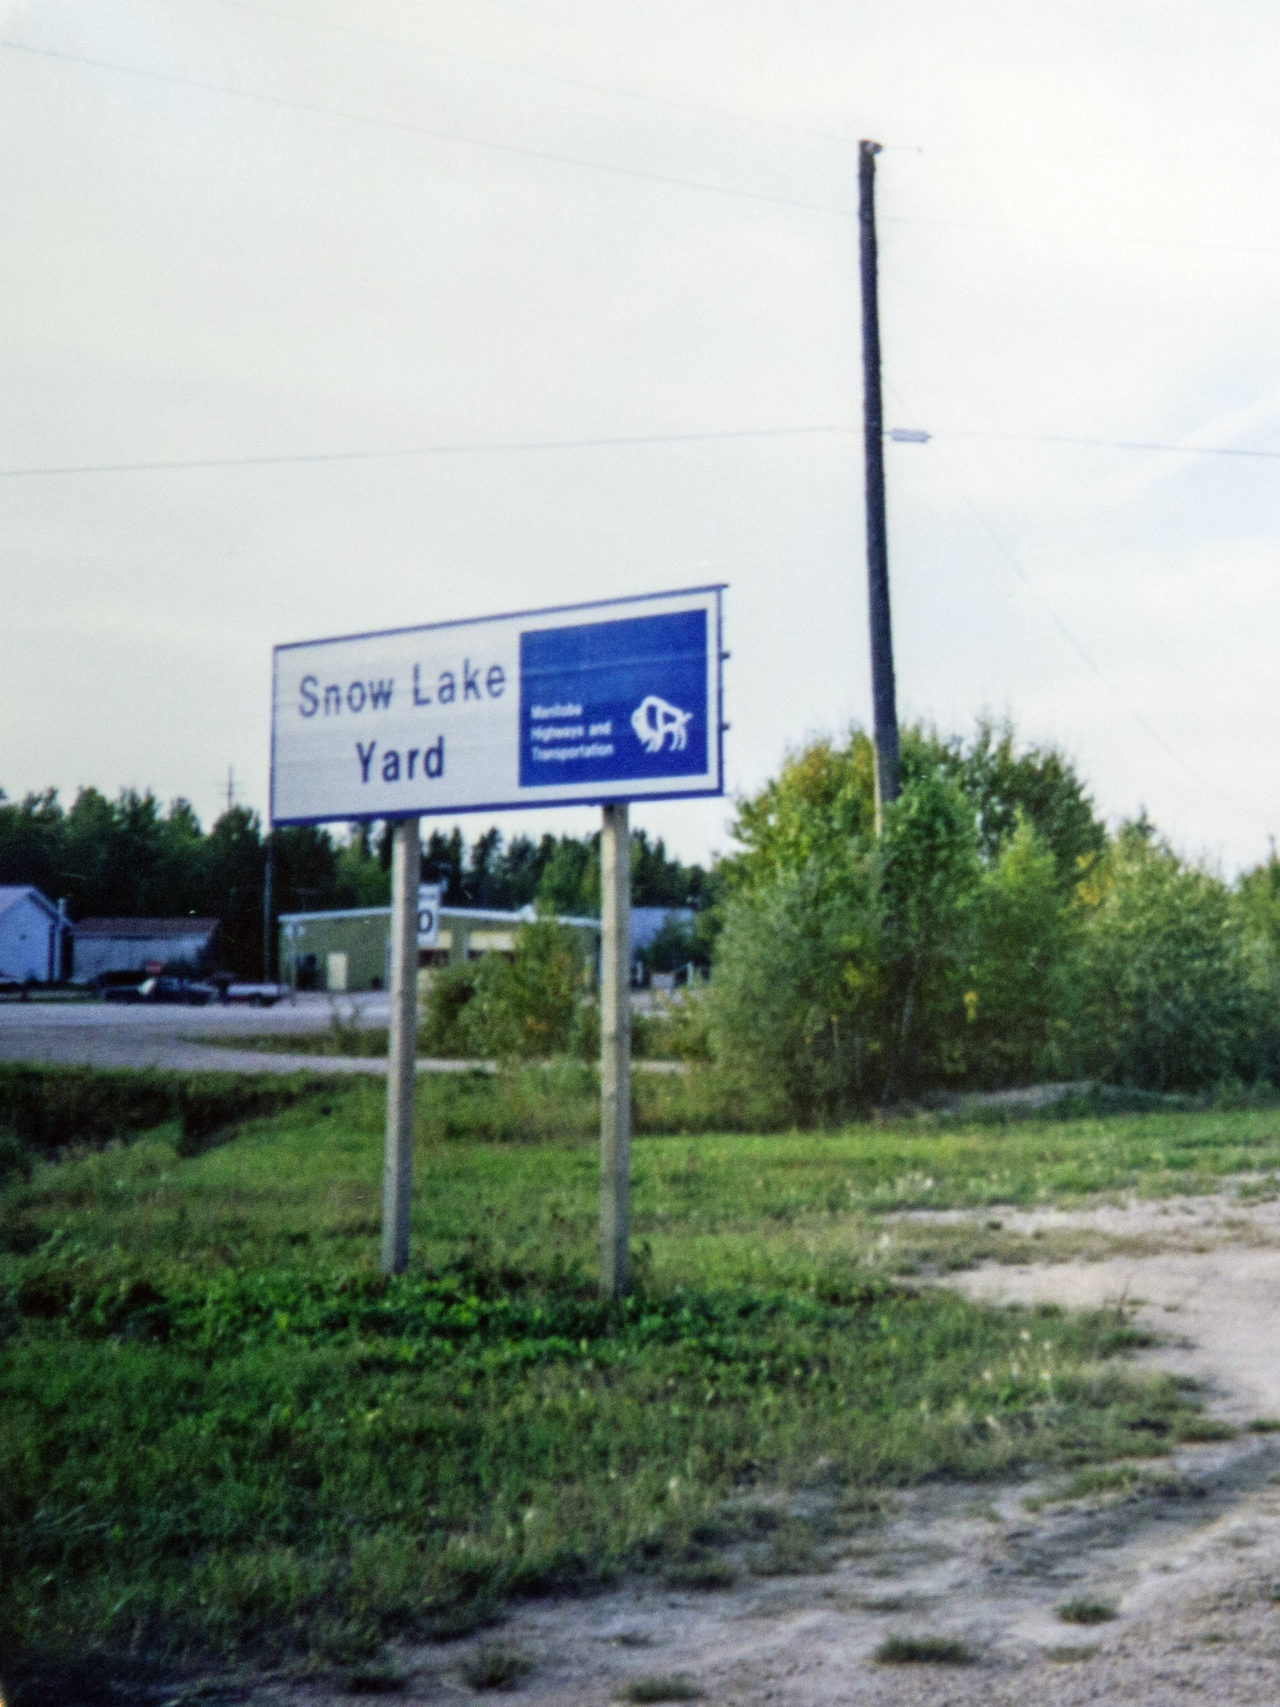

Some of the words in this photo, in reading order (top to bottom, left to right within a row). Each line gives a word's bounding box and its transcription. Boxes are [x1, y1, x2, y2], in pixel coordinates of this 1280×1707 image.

[298, 675, 395, 718] Snow
[412, 659, 507, 707] Lake
[530, 725, 585, 742] Highways
[588, 720, 612, 736] and
[356, 735, 446, 783] Yard
[531, 744, 615, 761] Transportation
